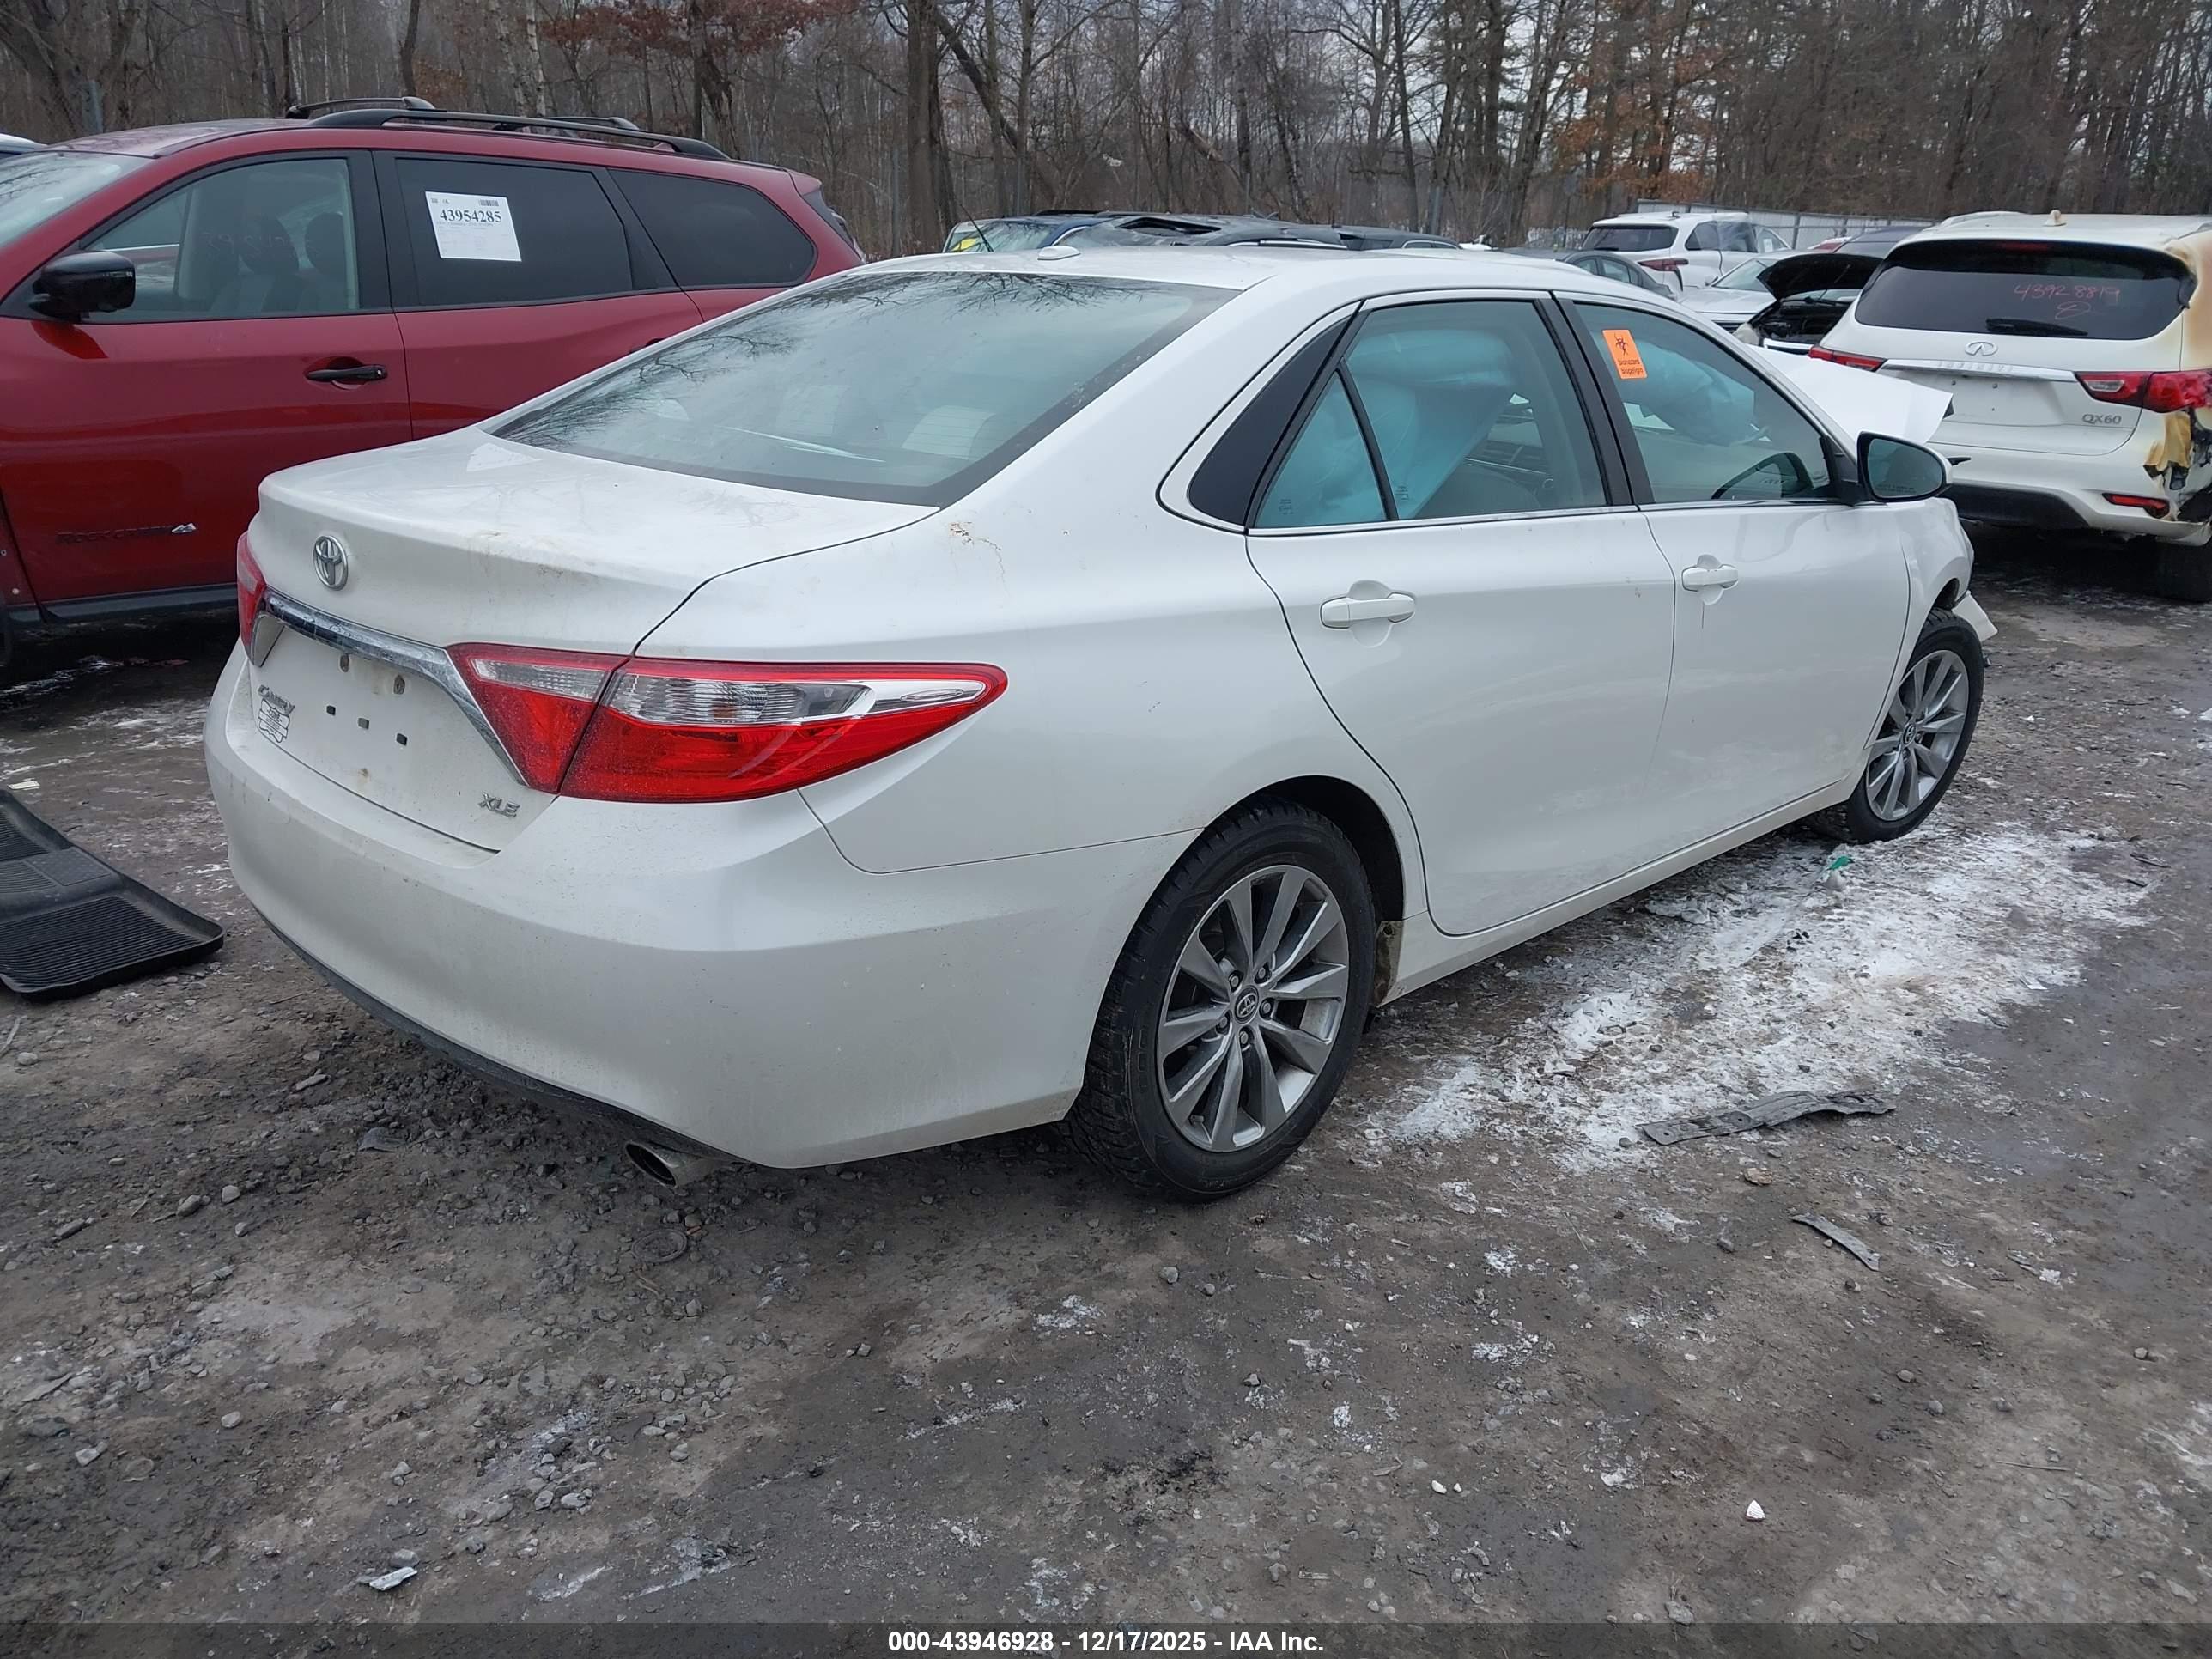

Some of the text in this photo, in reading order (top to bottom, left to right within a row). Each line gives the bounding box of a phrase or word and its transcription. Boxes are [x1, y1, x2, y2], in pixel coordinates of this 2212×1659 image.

[440, 209, 502, 223] 43954285
[2082, 413, 2122, 425] QX60
[477, 789, 521, 818] XLE
